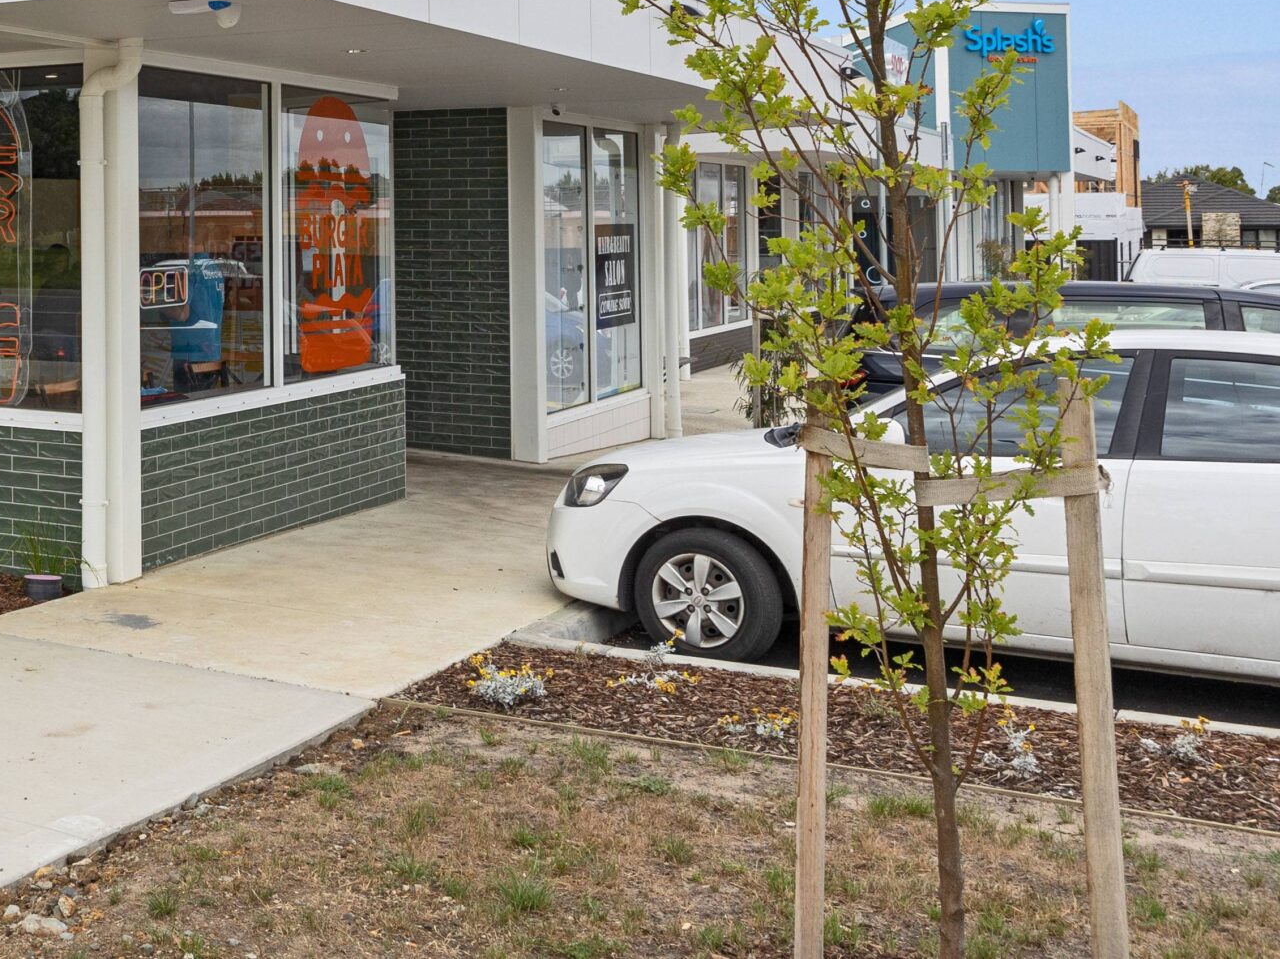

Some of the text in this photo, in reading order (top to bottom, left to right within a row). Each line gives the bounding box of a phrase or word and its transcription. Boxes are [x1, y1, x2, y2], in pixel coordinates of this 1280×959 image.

[299, 210, 370, 249] BURGER
[140, 271, 187, 305] OPEN
[312, 253, 364, 290] PLAYA
[605, 260, 625, 286] SALON
[600, 299, 618, 314] COMING
